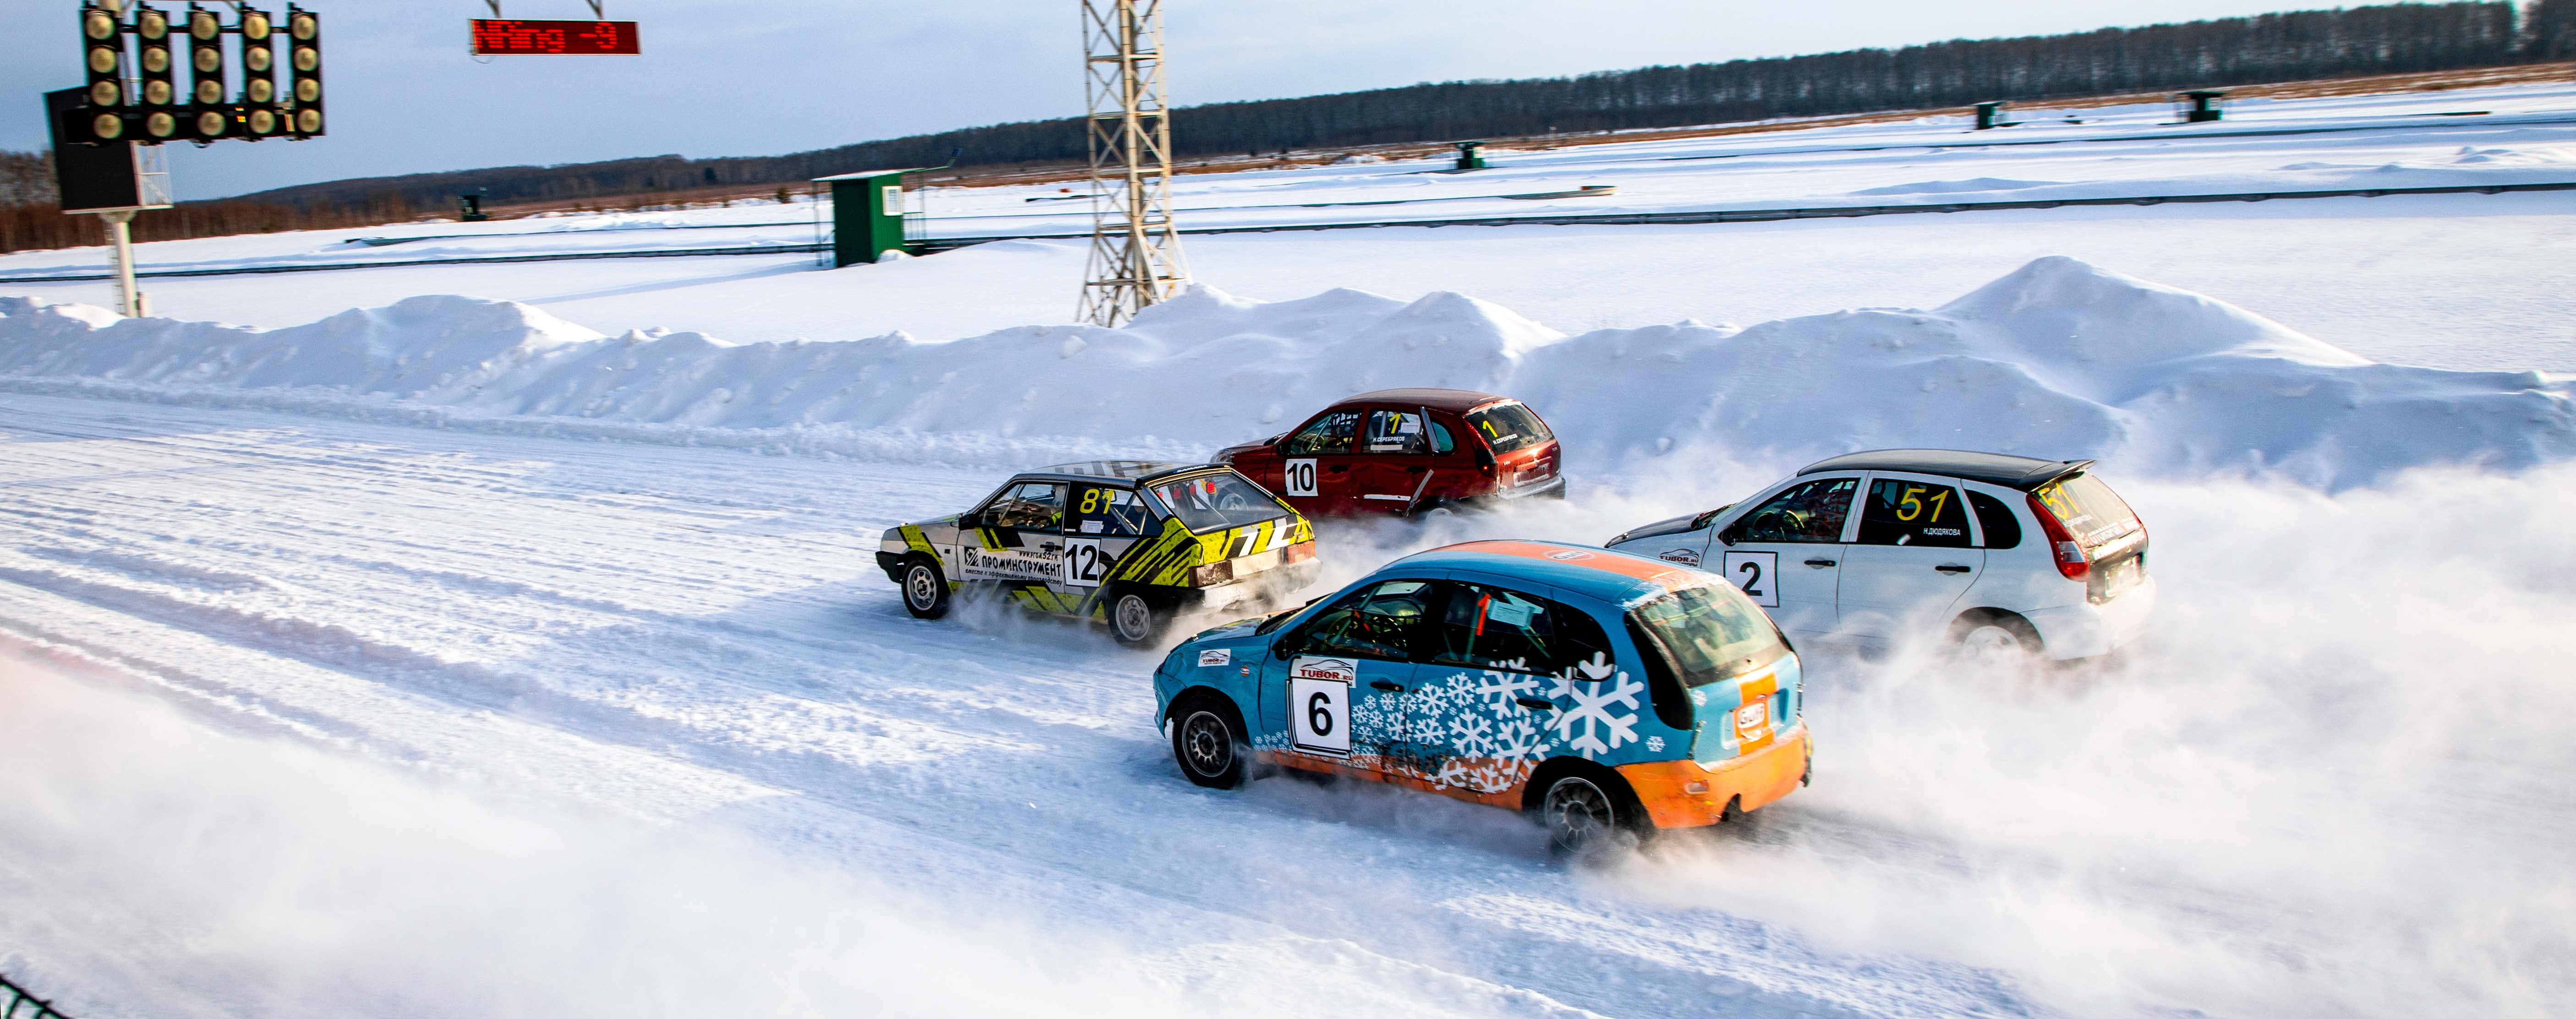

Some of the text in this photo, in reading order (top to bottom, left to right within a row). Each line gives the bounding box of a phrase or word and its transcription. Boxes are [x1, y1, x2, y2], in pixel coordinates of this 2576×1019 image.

[580, 22, 617, 49] -9
[1389, 414, 1401, 434] 1
[1482, 420, 1498, 437] 1
[1287, 463, 1314, 491] 10
[1080, 489, 1114, 514] 81
[1896, 488, 1949, 522] 51
[2038, 483, 2080, 519] 51
[982, 556, 1061, 577] ПРОМИНСТРУМЕНТ
[1065, 544, 1098, 581] 12
[1739, 561, 1762, 596] 2
[1308, 692, 1333, 736] 6
